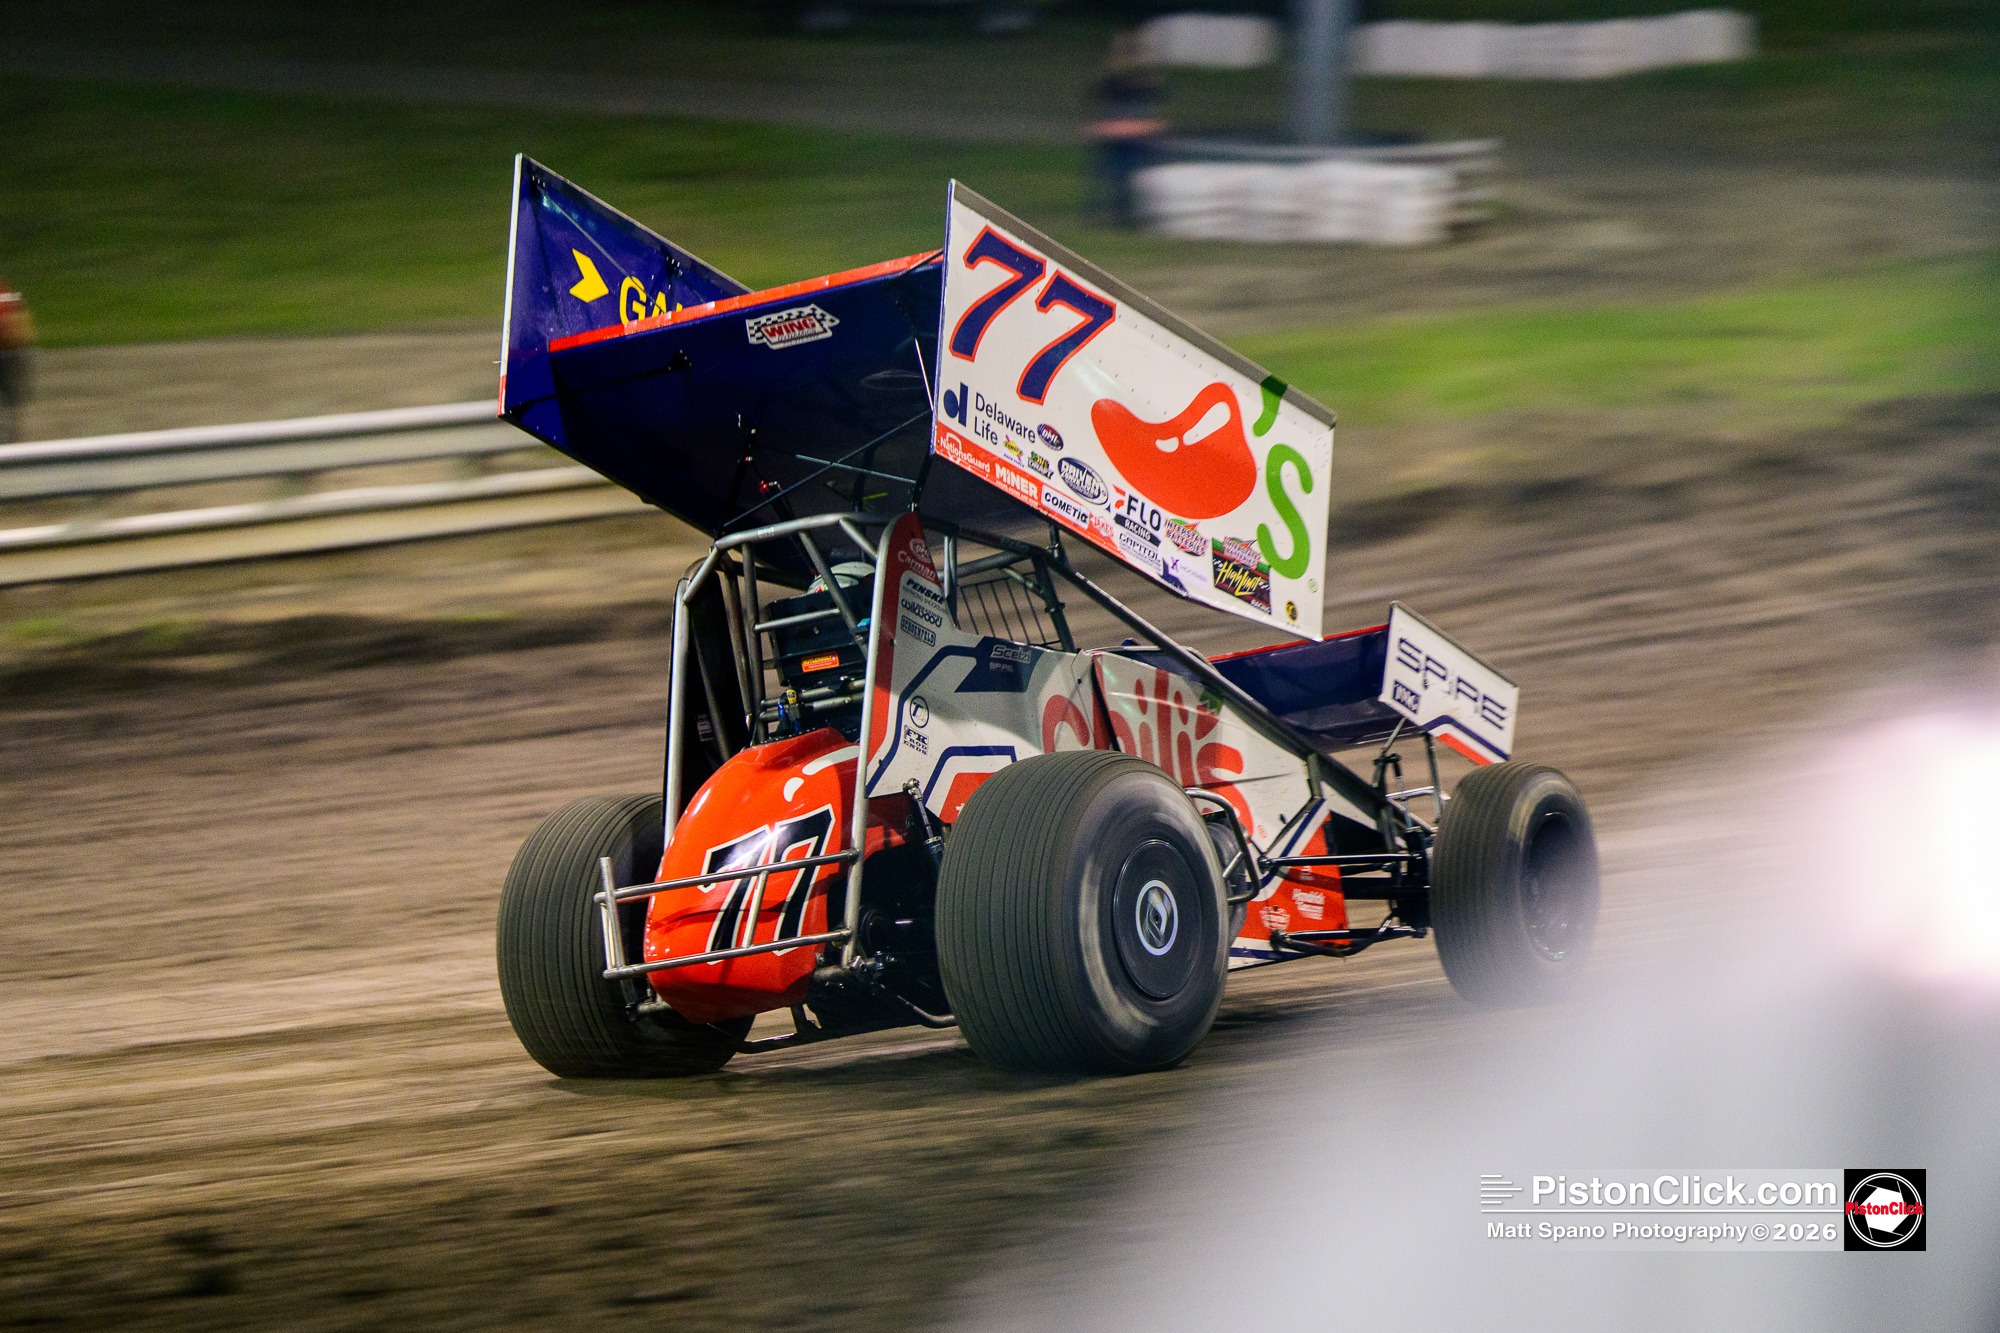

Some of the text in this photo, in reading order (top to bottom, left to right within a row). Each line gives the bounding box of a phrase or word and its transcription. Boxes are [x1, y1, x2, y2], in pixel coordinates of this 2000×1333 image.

[619, 276, 683, 325] GA
[764, 318, 817, 338] WING
[948, 225, 1117, 406] 77
[973, 416, 998, 445] Life
[975, 391, 1036, 444] Delaware
[939, 437, 990, 473] NationsGuard
[1044, 492, 1088, 523] COMETIC
[1126, 494, 1162, 532] FLO
[1125, 519, 1151, 541] RACING
[1164, 518, 1209, 547] INTERSTATE
[1166, 530, 1206, 557] BATTERIES
[904, 740, 927, 755] ENDS
[906, 729, 928, 746] FK
[908, 738, 928, 750] ROD
[697, 803, 836, 966] 77
